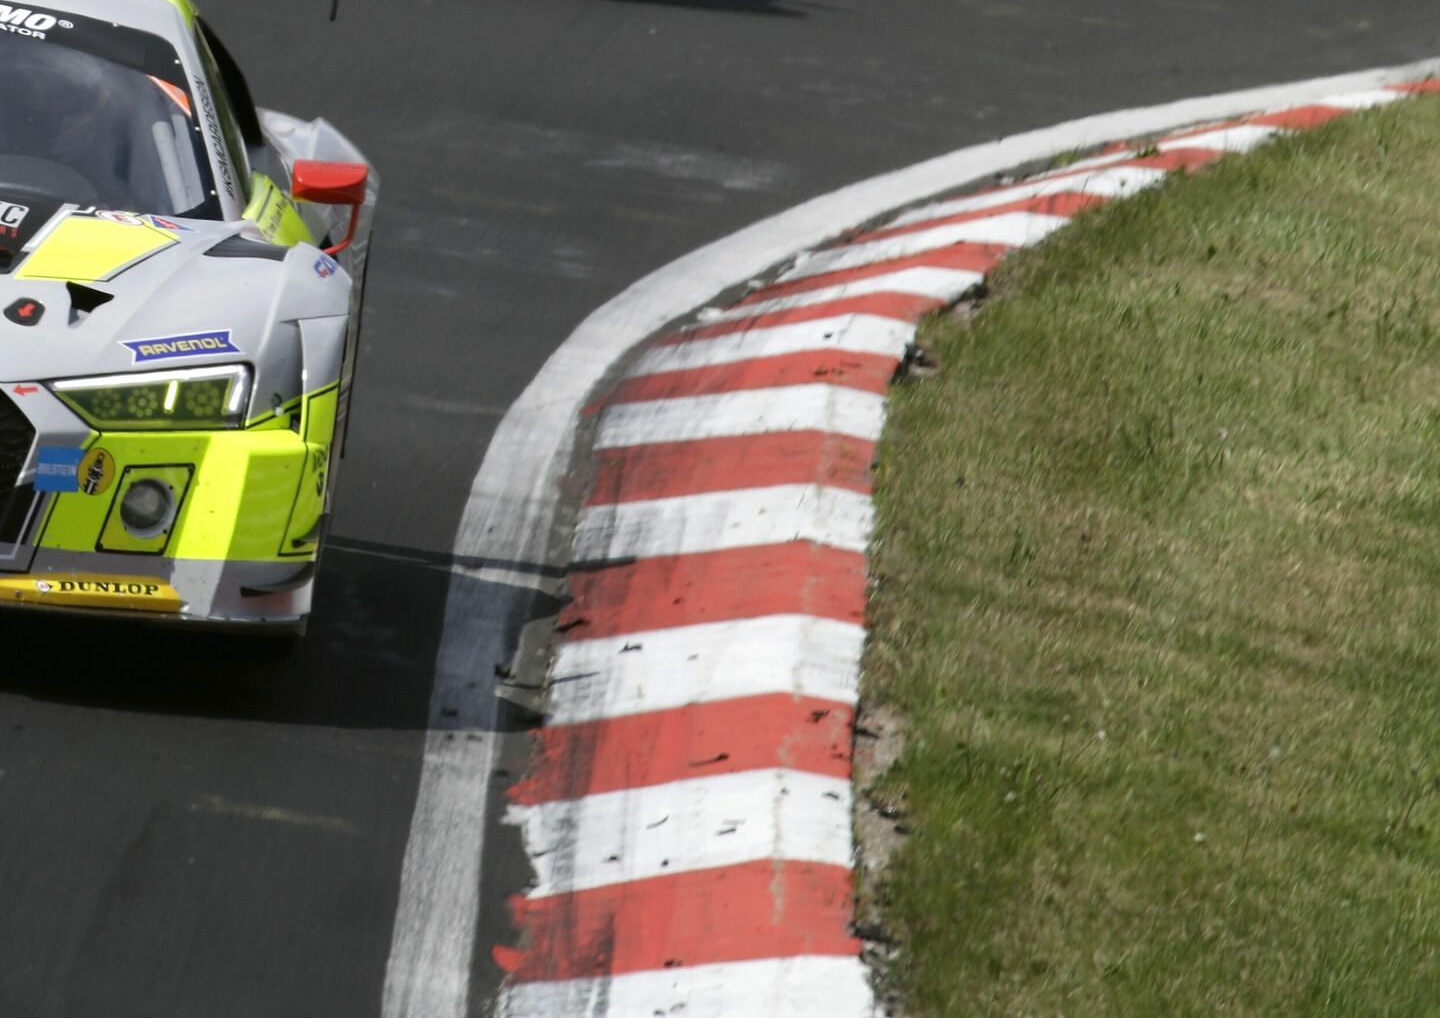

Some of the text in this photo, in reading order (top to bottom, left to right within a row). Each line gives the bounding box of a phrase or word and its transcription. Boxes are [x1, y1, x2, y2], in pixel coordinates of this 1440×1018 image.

[139, 337, 227, 357] RAVENOL
[37, 462, 78, 476] BILSTEIN
[59, 581, 160, 595] DUNLOP
